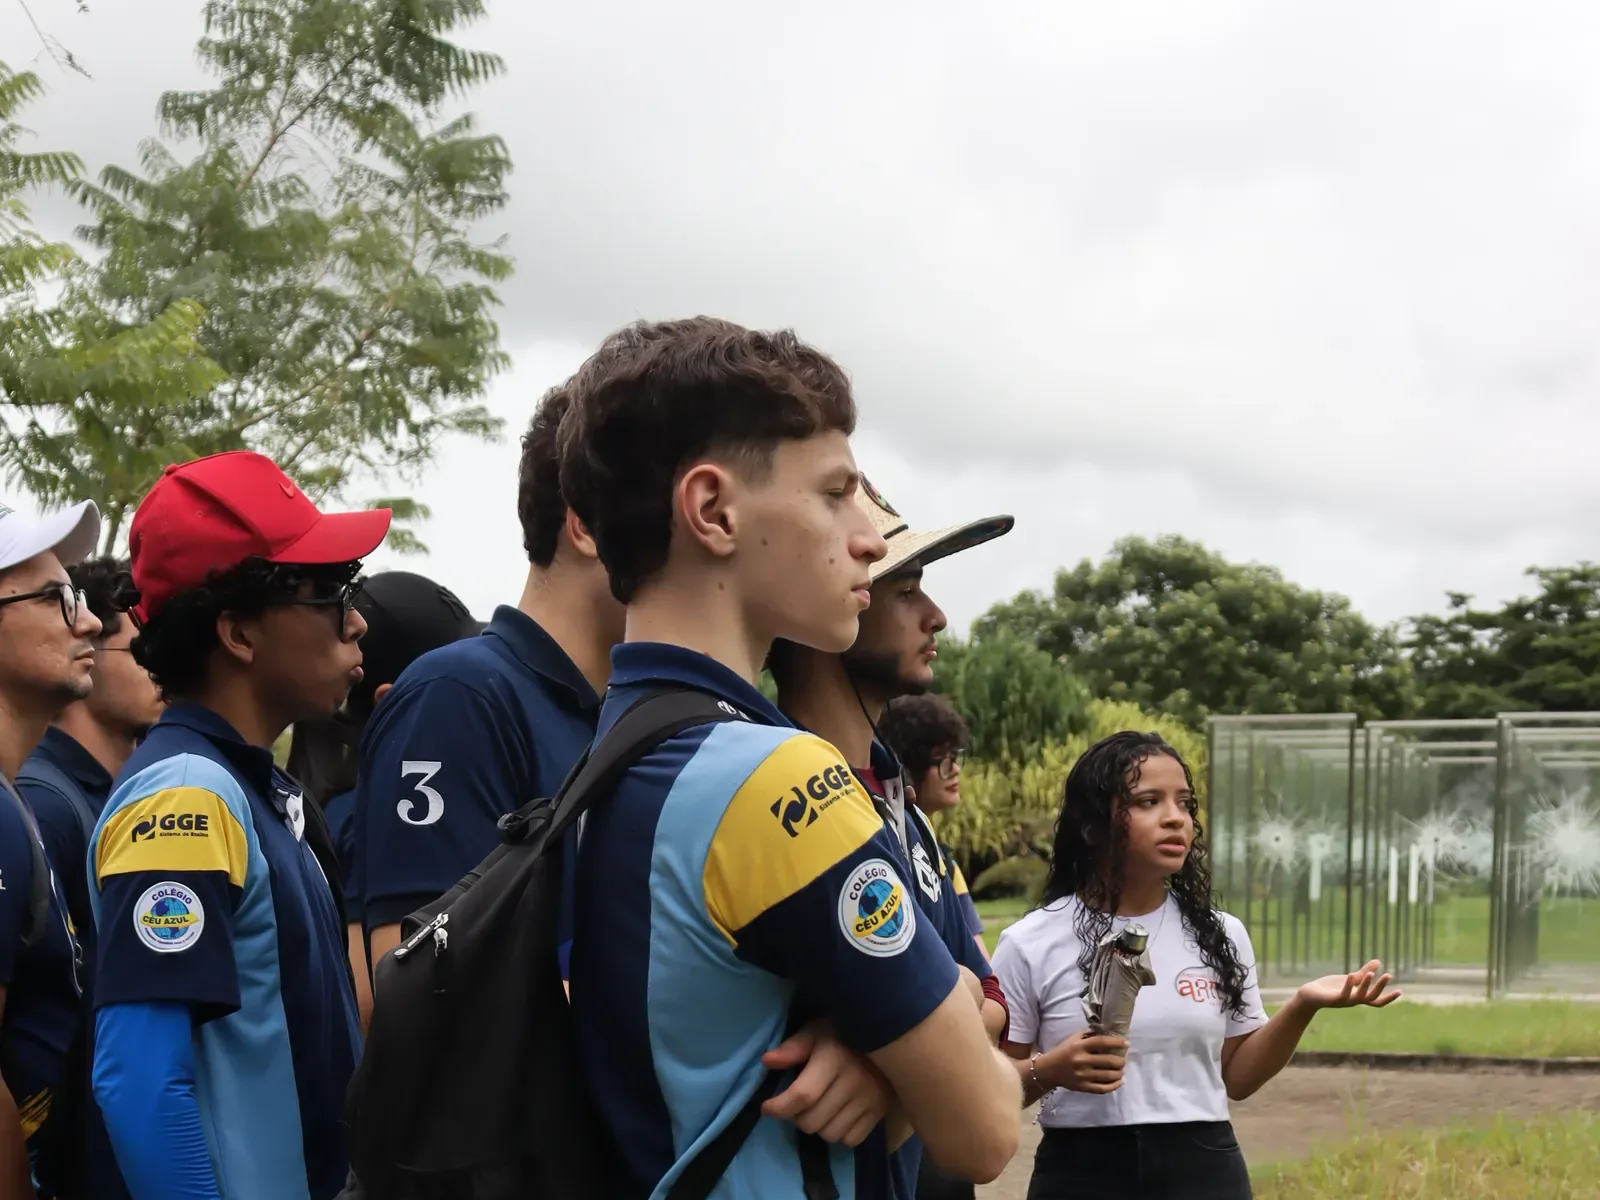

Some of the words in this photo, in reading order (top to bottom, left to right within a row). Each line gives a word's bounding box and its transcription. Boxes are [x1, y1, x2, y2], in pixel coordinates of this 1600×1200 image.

[397, 760, 445, 825] 3
[806, 764, 852, 800] GGE
[159, 813, 209, 831] GGE
[151, 888, 192, 905] COLÉGIO
[849, 867, 887, 901] COLÉGIO
[142, 915, 162, 925] CÉU
[163, 916, 190, 925] AZUL
[855, 915, 879, 933] CÉU
[880, 894, 898, 919] AZUL
